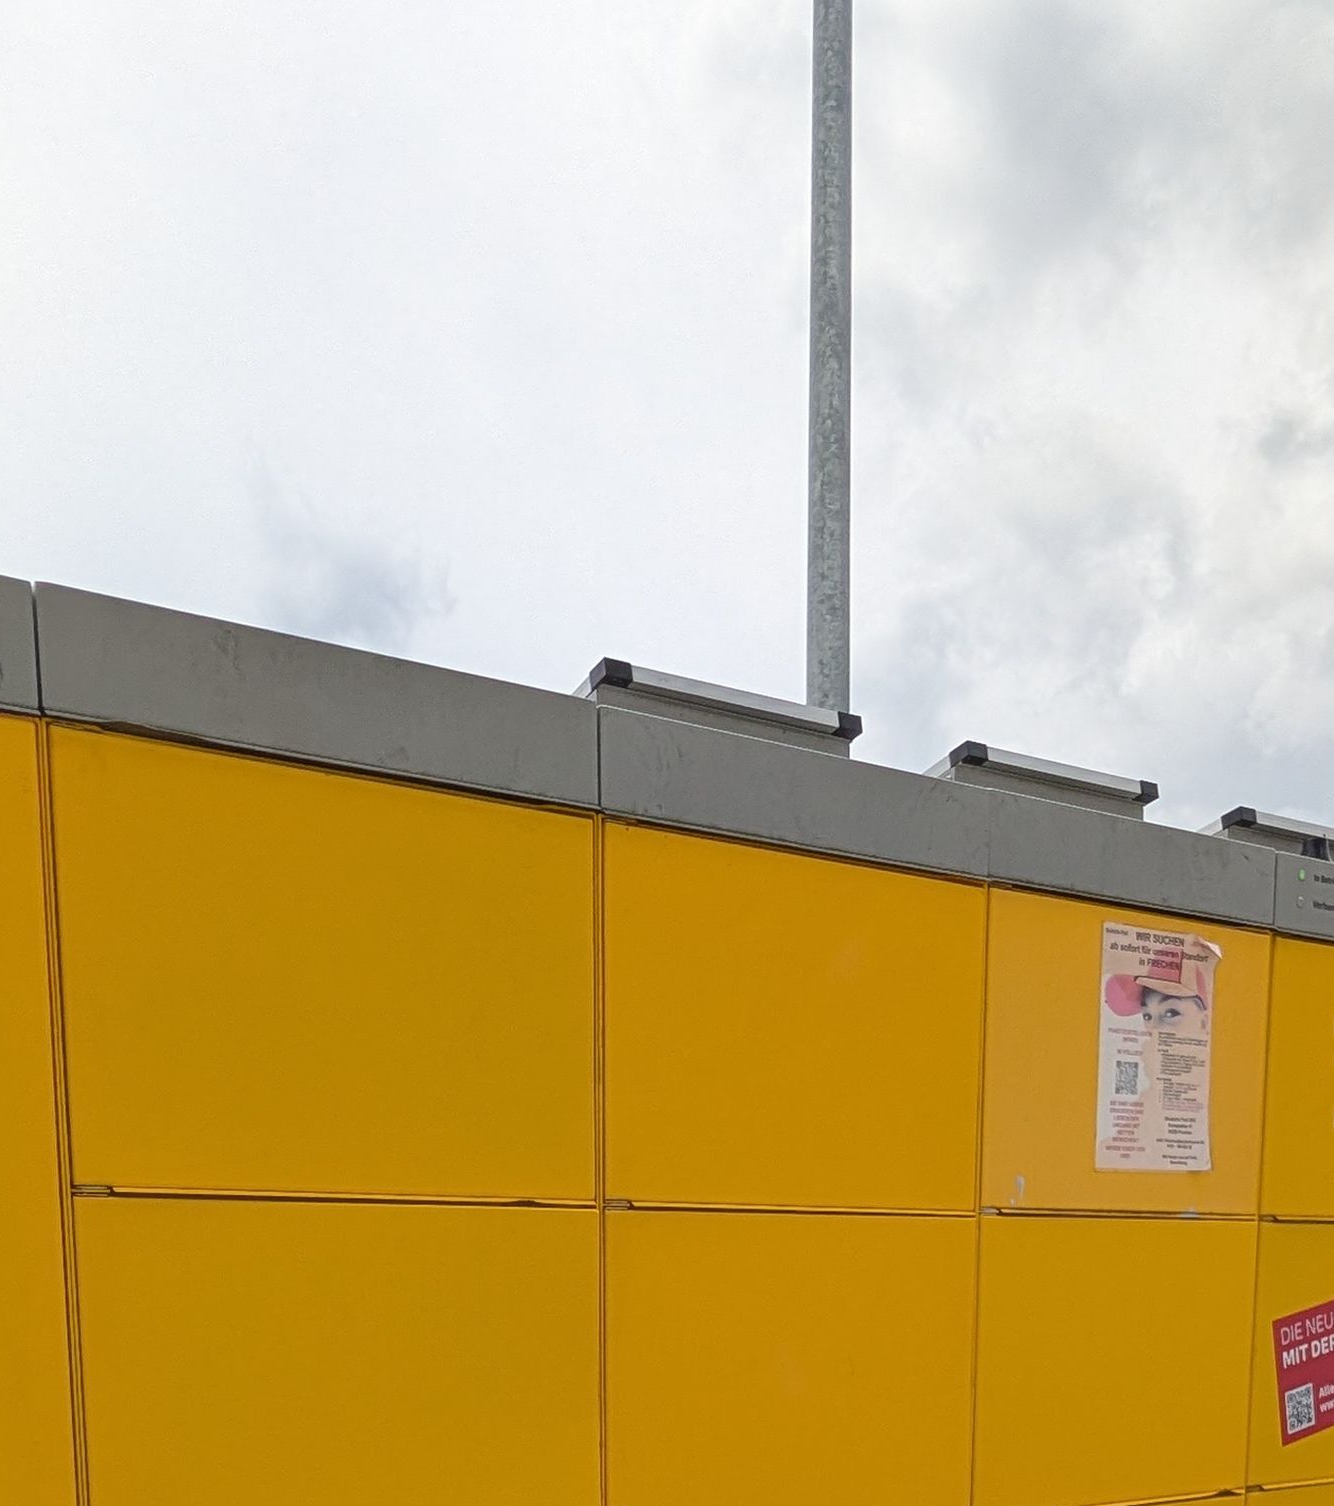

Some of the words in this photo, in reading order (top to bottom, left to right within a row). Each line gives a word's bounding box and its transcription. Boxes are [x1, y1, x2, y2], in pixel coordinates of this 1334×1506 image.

[1152, 933, 1185, 947] SUCHEN
[1120, 943, 1141, 953] sofort
[1280, 1321, 1303, 1346] DIE
[1282, 1343, 1308, 1369] MIT
[1319, 1384, 1334, 1399] Alle
